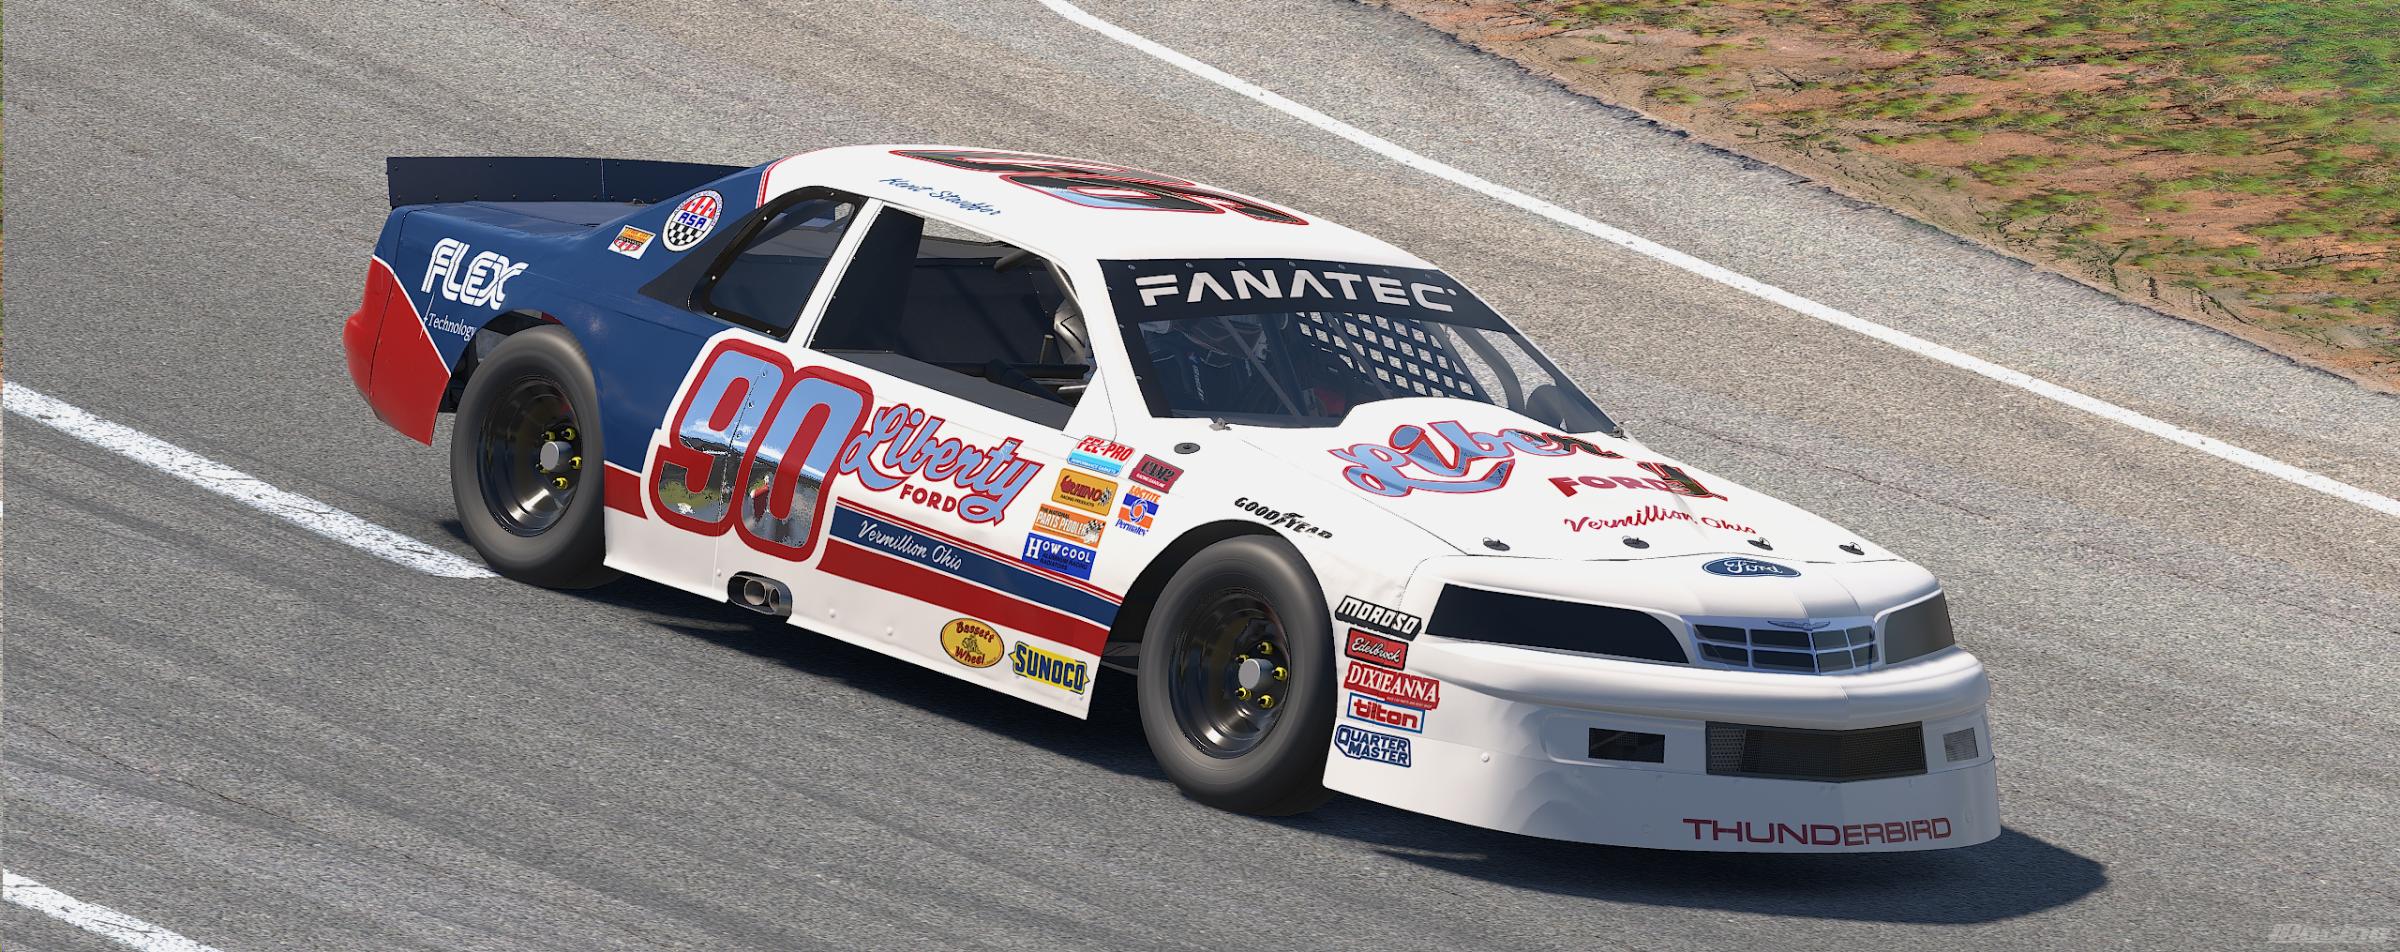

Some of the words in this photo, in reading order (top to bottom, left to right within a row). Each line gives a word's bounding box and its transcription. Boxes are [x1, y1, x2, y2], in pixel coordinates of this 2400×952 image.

[678, 212, 707, 229] ASA
[421, 238, 529, 310] FLEX
[1136, 269, 1454, 312] FANATEC
[428, 312, 477, 342] Technology
[649, 338, 874, 562] 90
[1077, 436, 1135, 462] FEL-PRO
[838, 403, 1045, 526] Liberty
[899, 483, 957, 513] FORD
[1128, 485, 1162, 503] LOCTITE
[1549, 476, 1675, 498] FORD
[1035, 511, 1060, 529] PARTS
[1234, 496, 1333, 539] GOODYEAR
[1564, 505, 1698, 532] Vermillion
[1701, 517, 1756, 534] Ohio
[858, 520, 927, 559] Vermillion
[931, 545, 963, 571] Ohio
[1025, 537, 1092, 563] HOWCOOL
[1723, 559, 1784, 574] Ford
[1338, 596, 1420, 635] MOROSO
[955, 620, 995, 643] Bassett
[954, 644, 986, 665] Wheel
[1351, 637, 1401, 662] Edelbrock
[1015, 644, 1085, 691] SUNOCO
[1347, 664, 1437, 703] DIXIEANNA
[1354, 698, 1418, 729] tilton
[1337, 727, 1408, 752] QUARTER
[1347, 741, 1409, 765] MASTER
[1682, 817, 1951, 847] THUNDERBIRD
